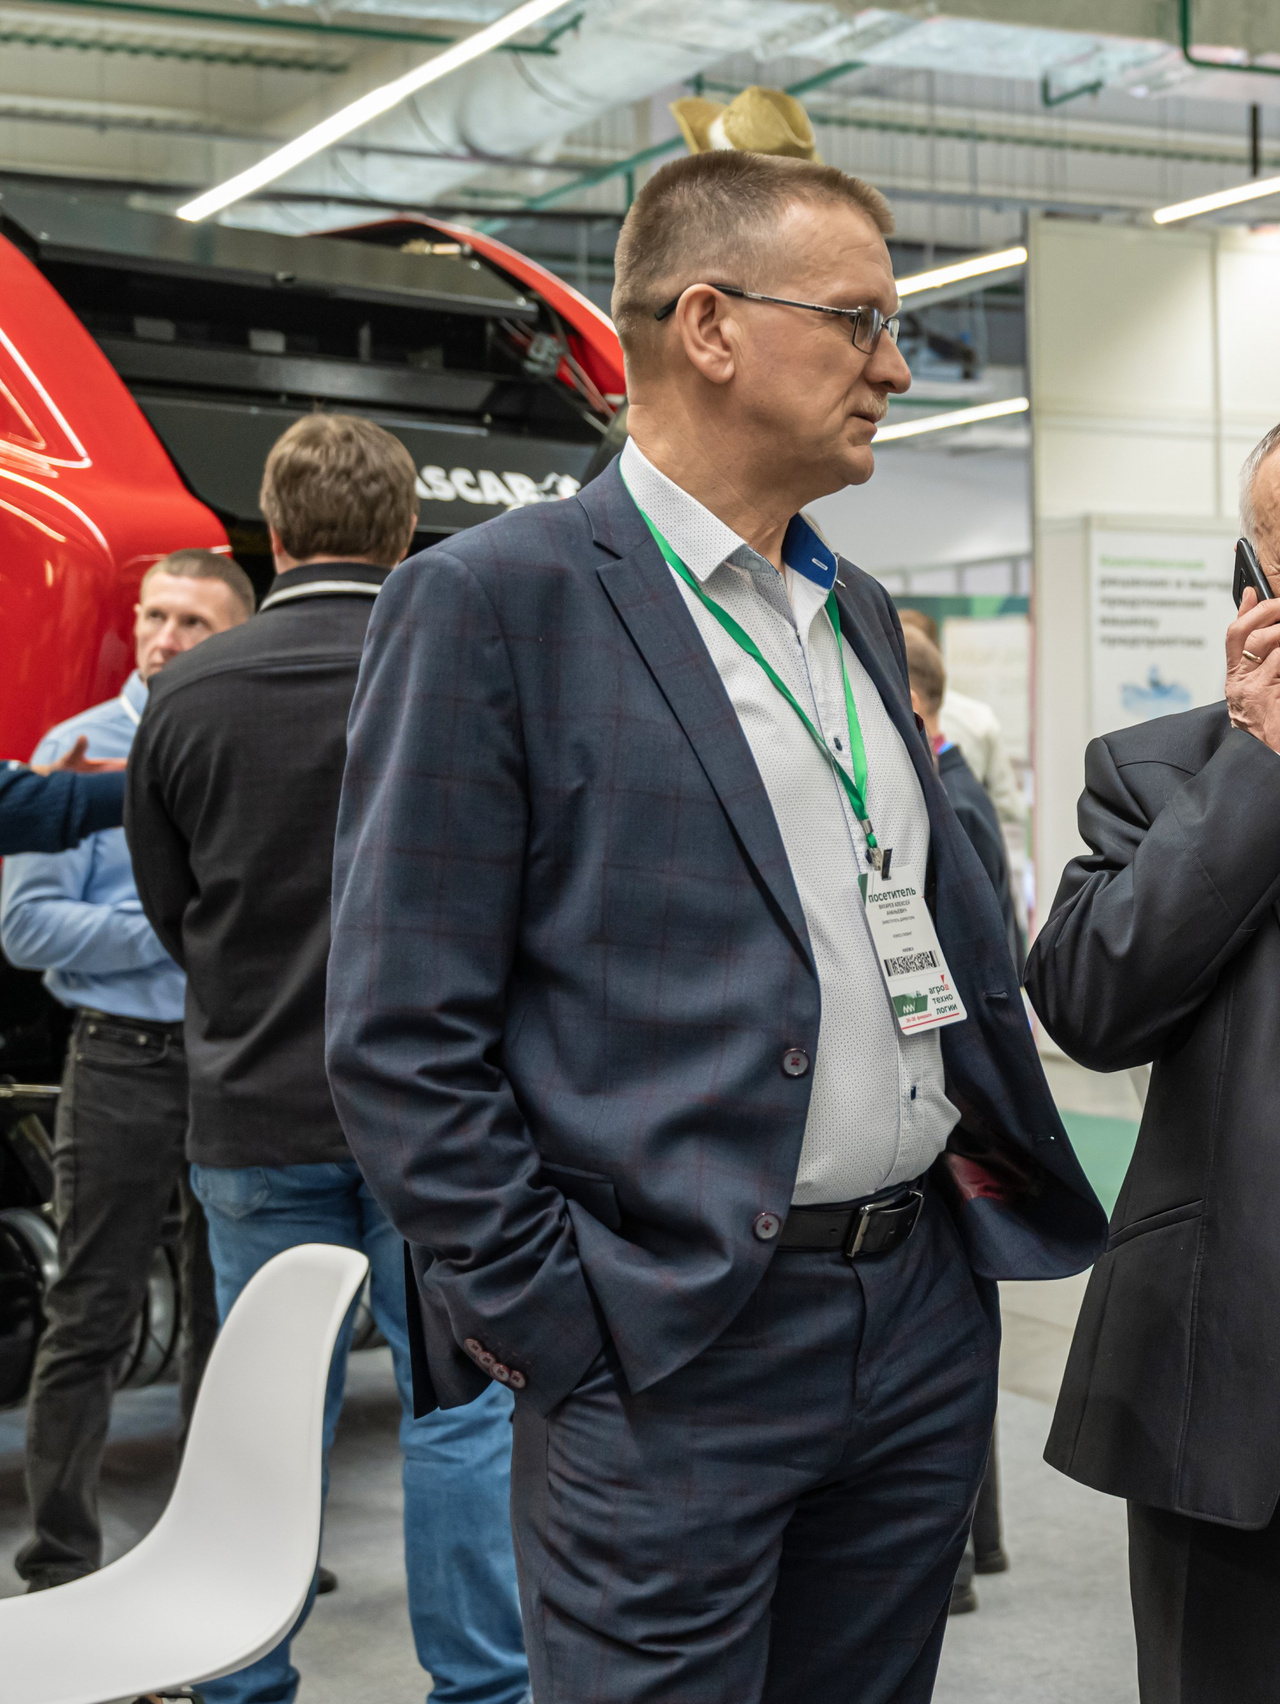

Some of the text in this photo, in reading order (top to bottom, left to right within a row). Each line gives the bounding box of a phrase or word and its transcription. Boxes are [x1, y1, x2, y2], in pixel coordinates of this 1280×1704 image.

[868, 886, 917, 904] посетитель
[928, 984, 946, 995] агро
[931, 993, 954, 1004] техно
[935, 1003, 958, 1015] логии
